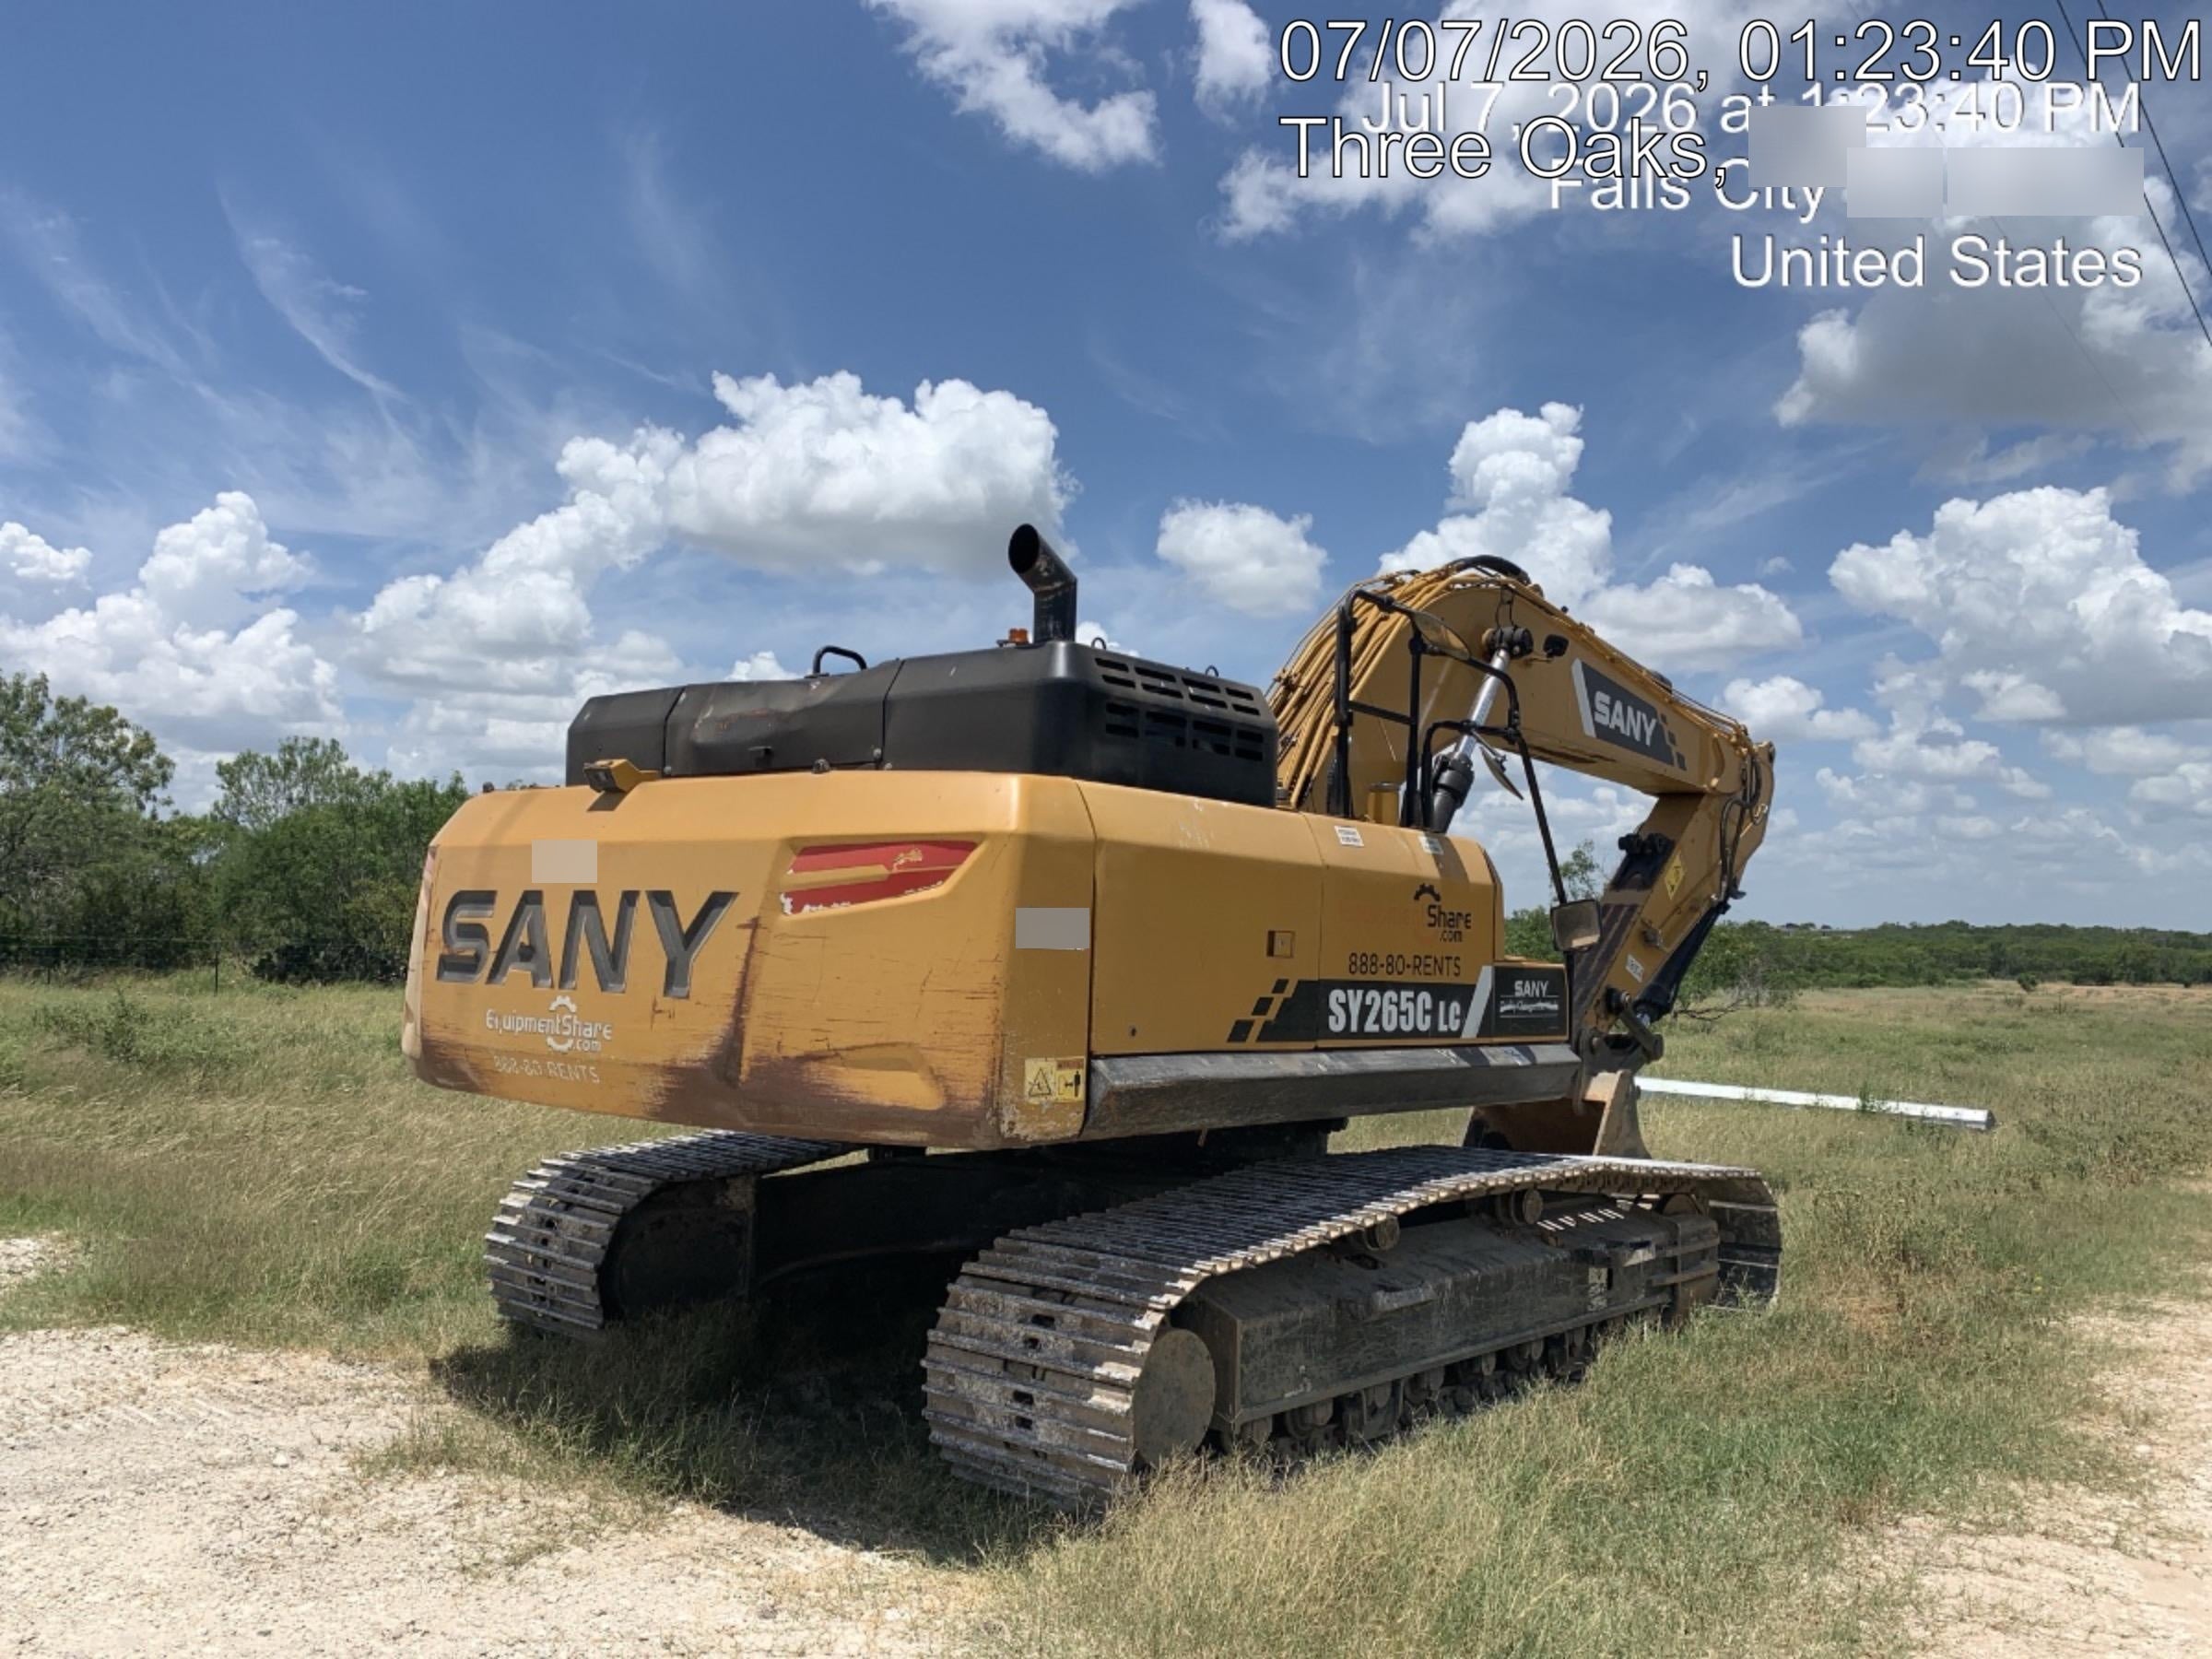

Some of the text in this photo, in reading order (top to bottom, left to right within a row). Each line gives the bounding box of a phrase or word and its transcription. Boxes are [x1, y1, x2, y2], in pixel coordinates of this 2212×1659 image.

[1593, 690, 1658, 748] SANY
[1427, 904, 1473, 930] Share
[436, 889, 740, 1000] SANY
[1439, 929, 1464, 943] .com
[1347, 952, 1462, 977] 888-80-RENTS
[1513, 980, 1549, 998] SANY
[1327, 988, 1462, 1033] SY265C LC
